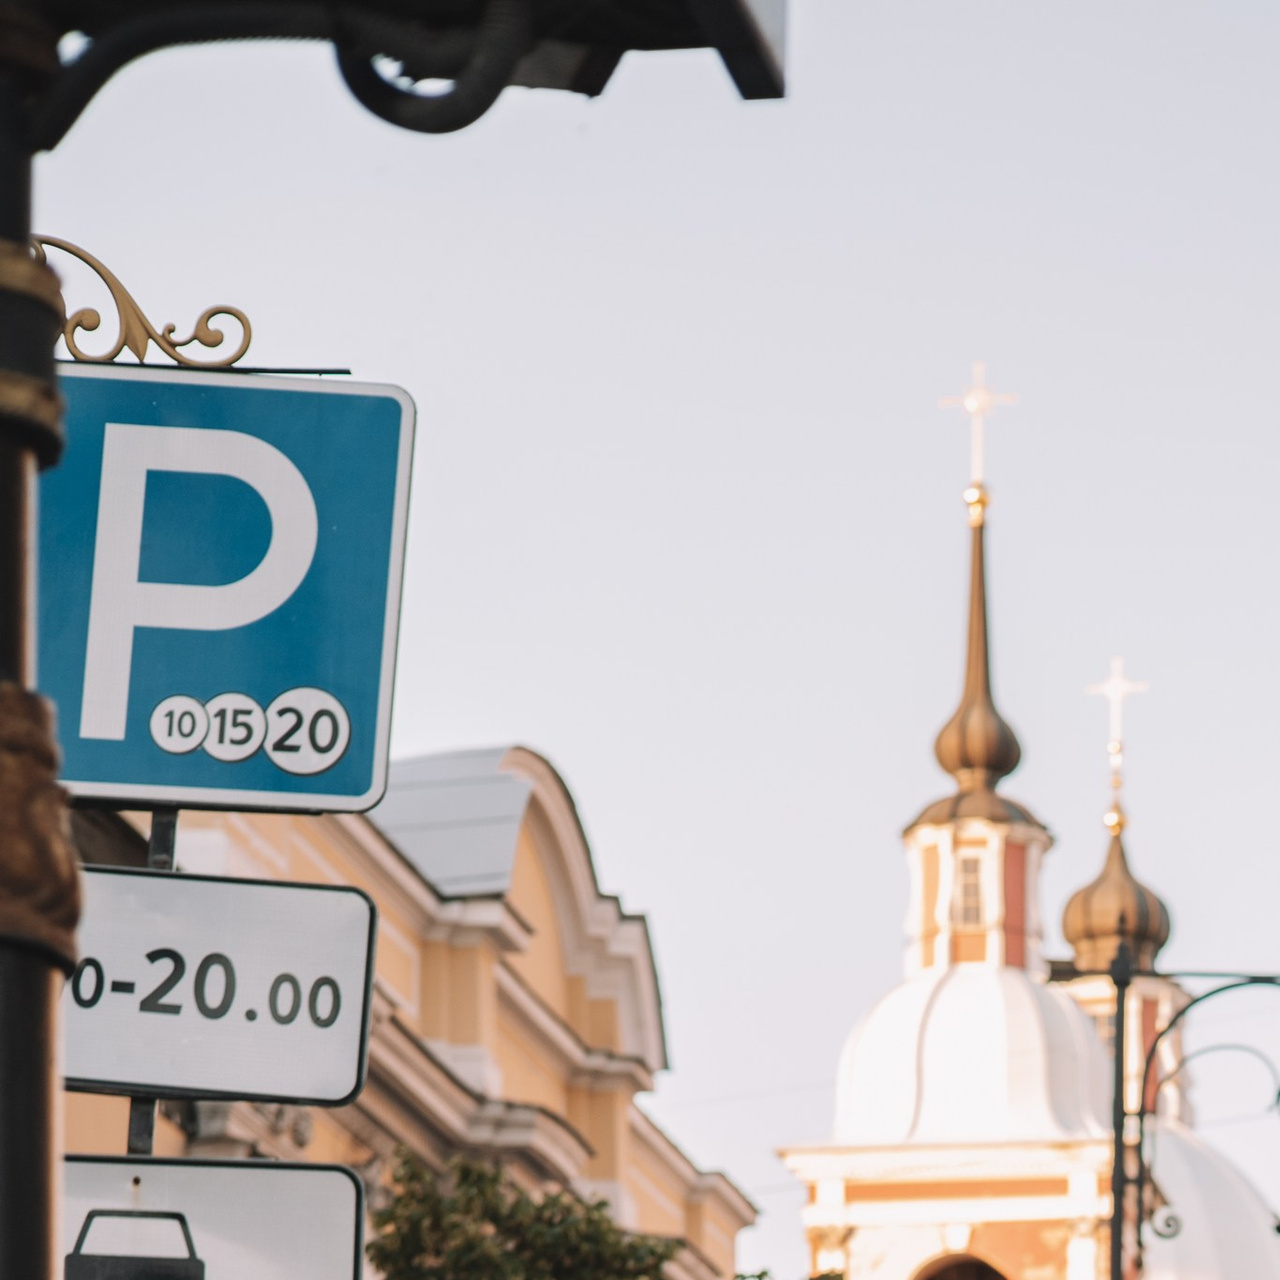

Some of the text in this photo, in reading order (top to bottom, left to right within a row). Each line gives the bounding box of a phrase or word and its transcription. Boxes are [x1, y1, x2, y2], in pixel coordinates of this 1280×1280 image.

[79, 422, 319, 741] P
[163, 706, 339, 755] 10 15 20
